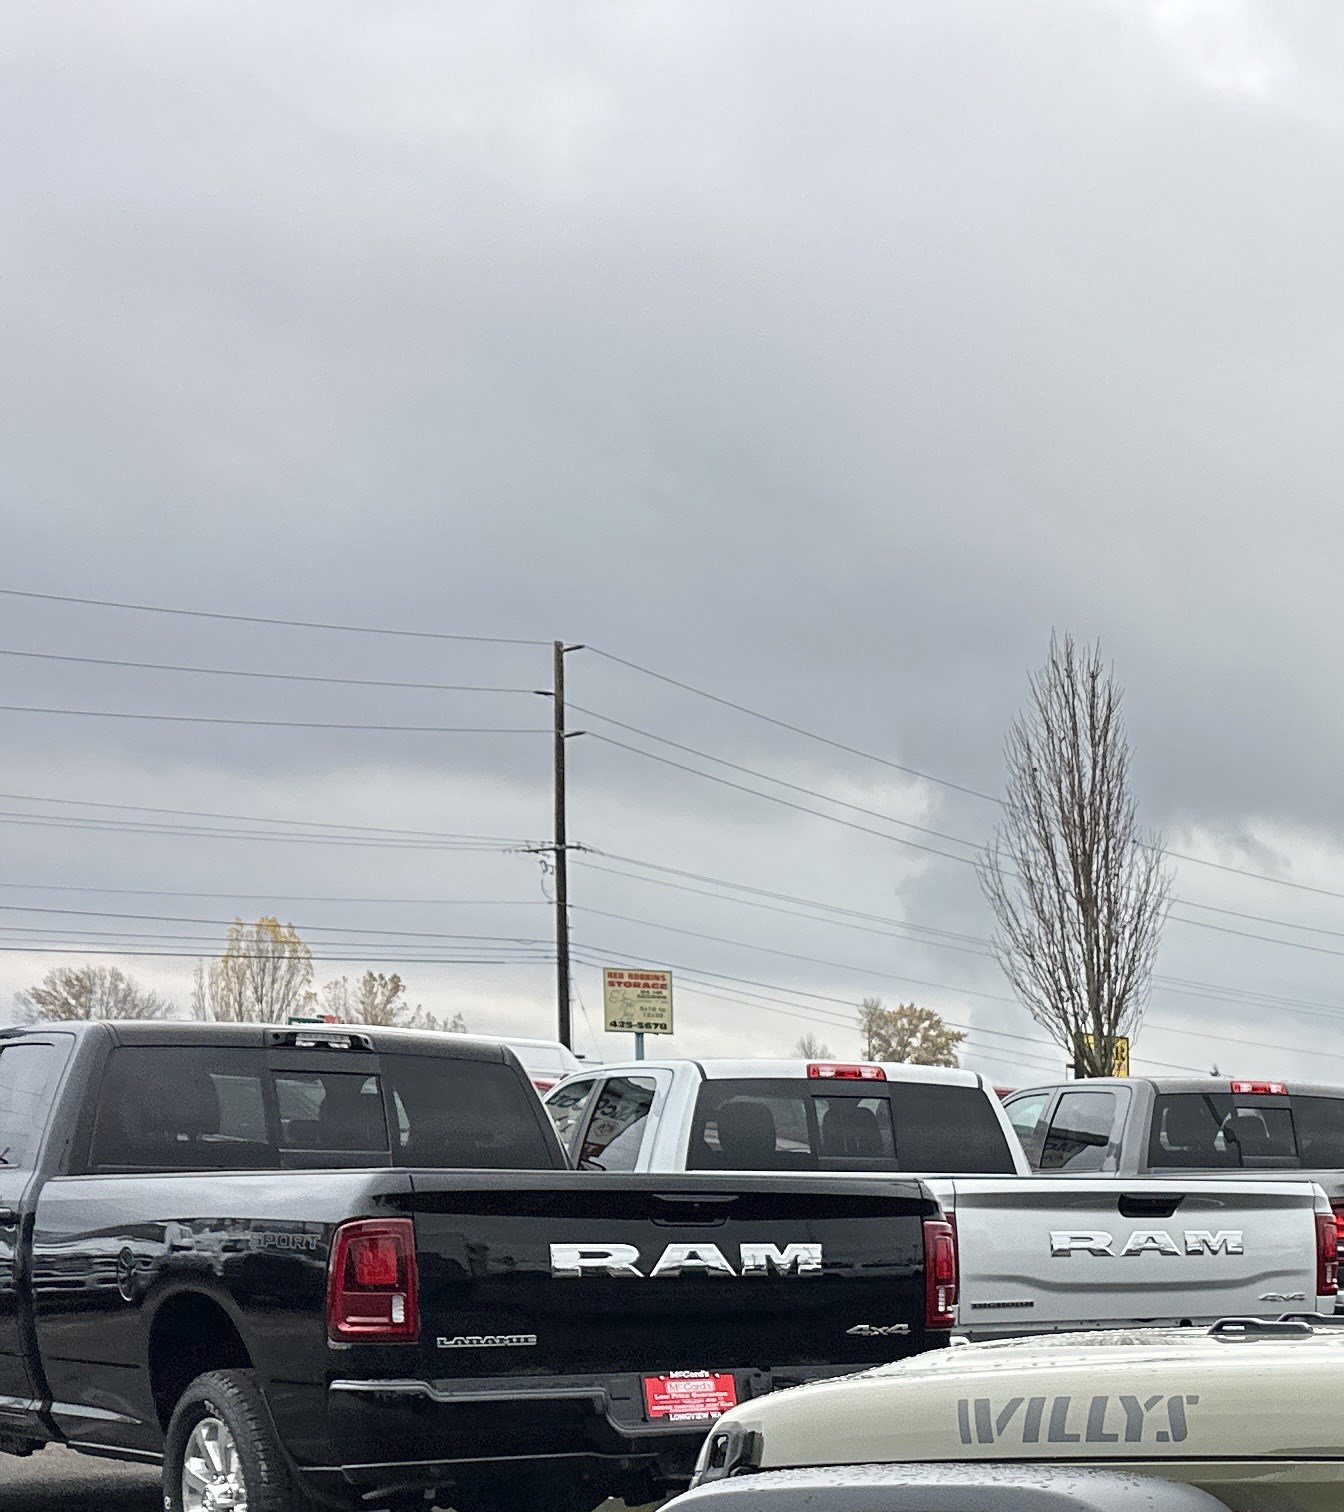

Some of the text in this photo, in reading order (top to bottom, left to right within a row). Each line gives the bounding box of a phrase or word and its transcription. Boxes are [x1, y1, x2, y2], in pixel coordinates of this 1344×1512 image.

[608, 981, 667, 989] STORAGE
[609, 1020, 668, 1030] 425-5678
[249, 1231, 321, 1250] SPORT
[1049, 1230, 1244, 1258] RAM
[550, 1243, 823, 1277] RAM
[437, 1335, 536, 1348] LARAMIE
[669, 1412, 709, 1421] LONGVIEW
[958, 1395, 1200, 1444] WILLYS
